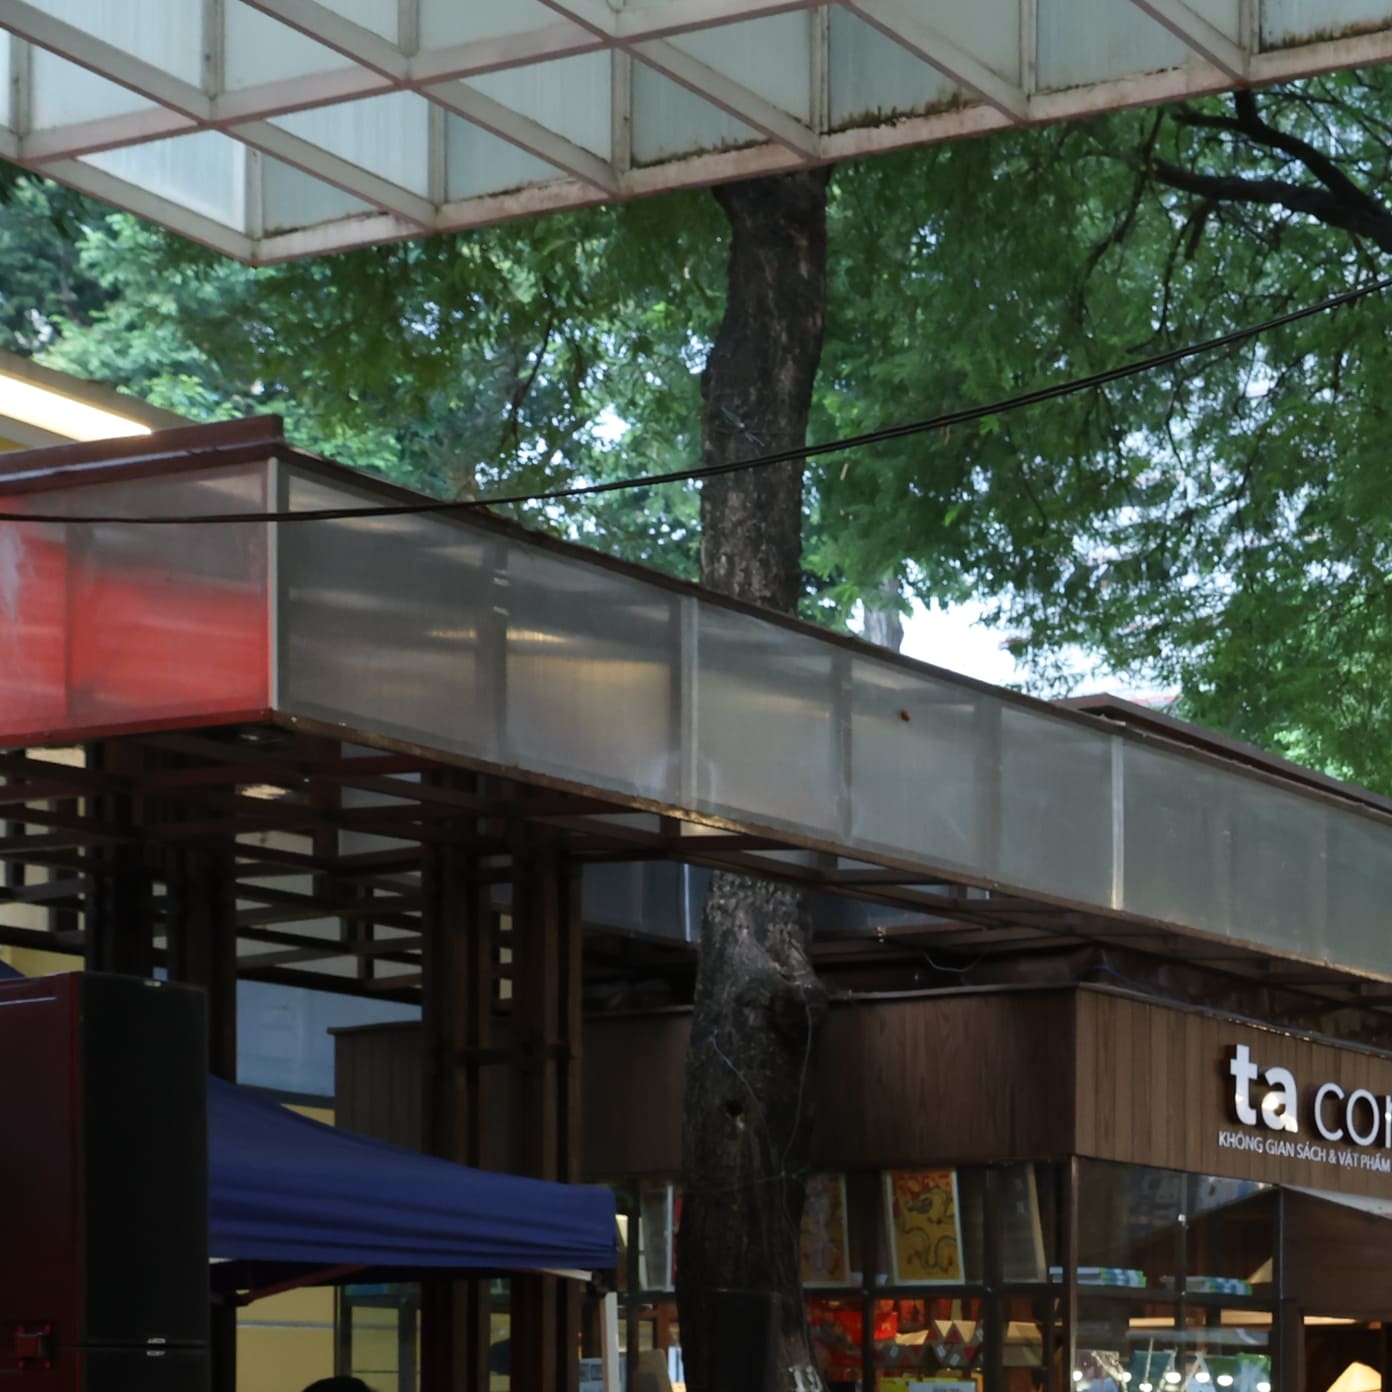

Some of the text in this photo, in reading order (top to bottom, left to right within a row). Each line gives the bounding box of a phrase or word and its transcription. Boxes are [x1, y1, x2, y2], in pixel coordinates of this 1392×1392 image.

[1230, 1044, 1298, 1133] ta
[1219, 1128, 1263, 1153] KHÔNG
[1265, 1138, 1295, 1158] GIAN
[1296, 1141, 1326, 1162] SÁCH
[1328, 1151, 1336, 1163] &
[1338, 1150, 1358, 1170] VẬT
